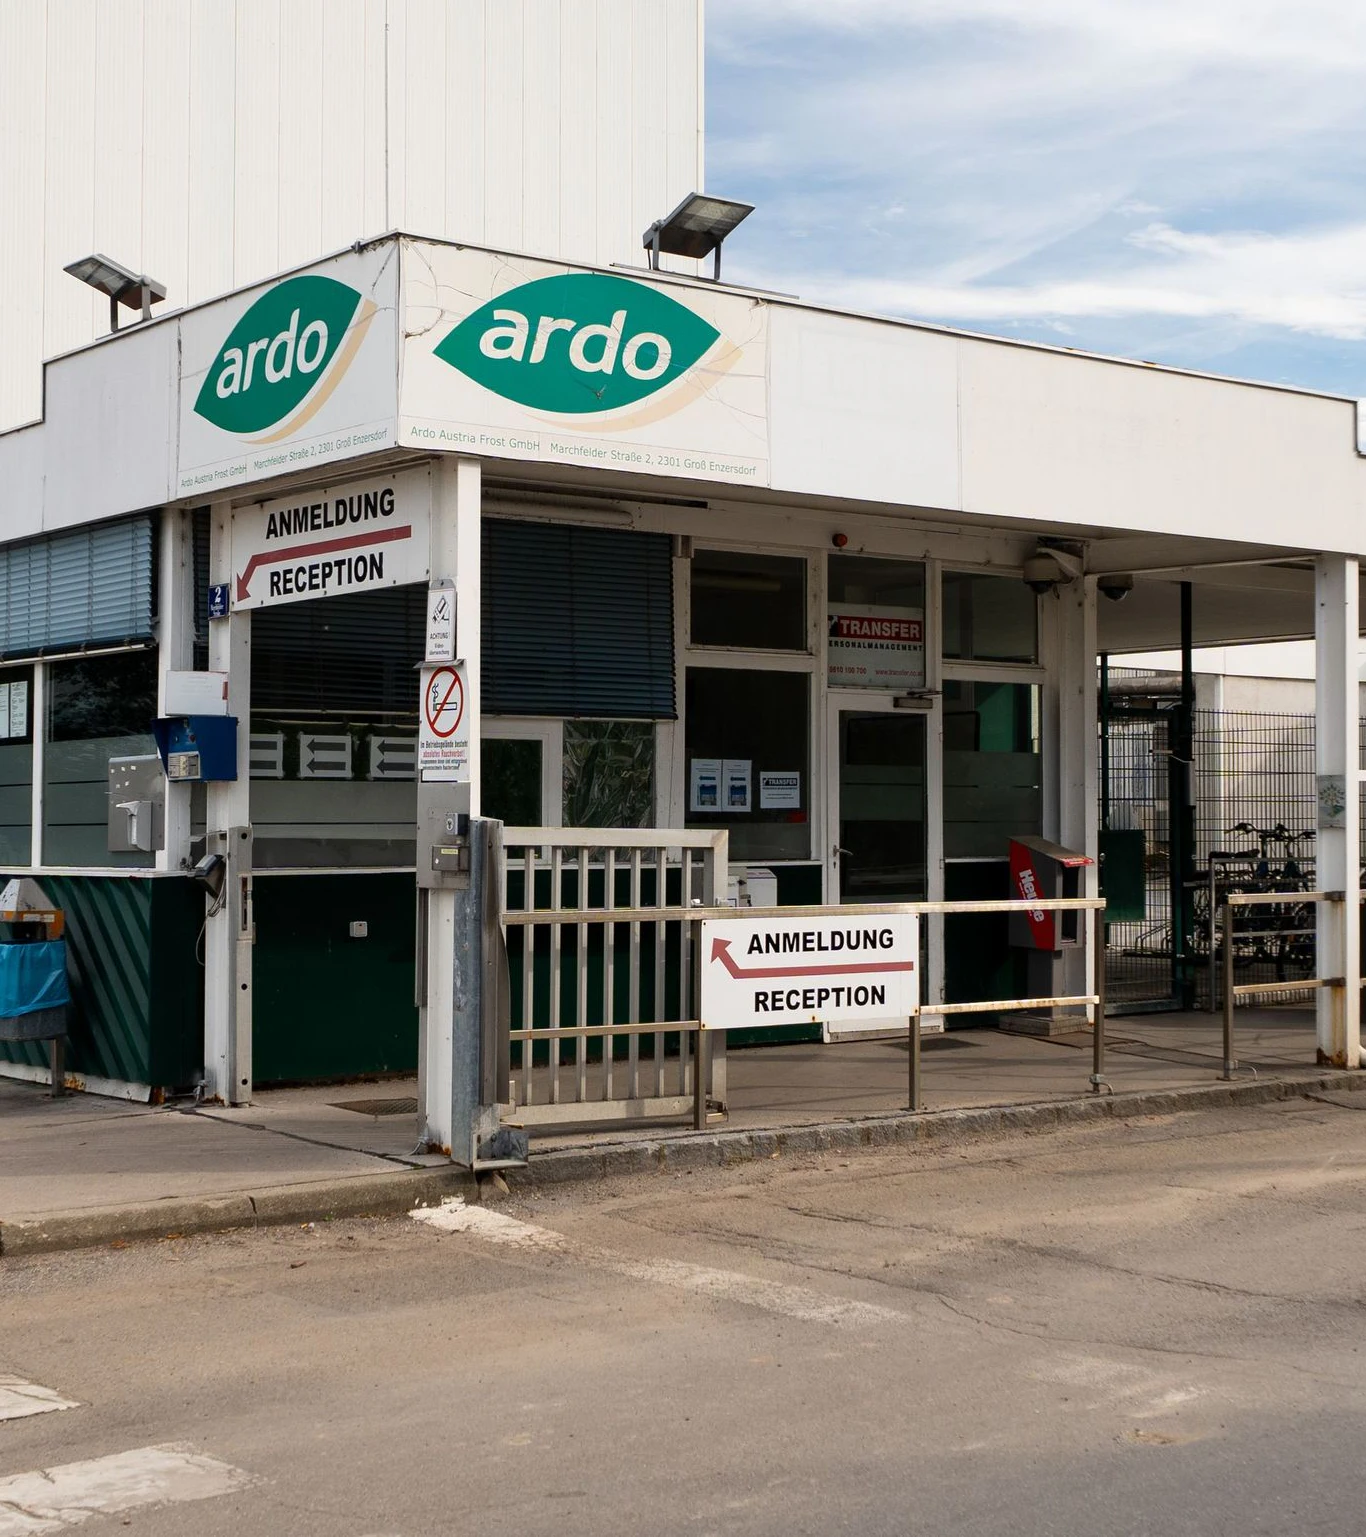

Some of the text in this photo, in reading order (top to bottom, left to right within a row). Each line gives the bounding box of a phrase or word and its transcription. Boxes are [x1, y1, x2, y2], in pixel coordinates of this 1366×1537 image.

[216, 308, 329, 399] ardo
[479, 309, 672, 380] ardo
[253, 428, 388, 471] Marchfelder Straße 2, 2301 Groß Enzersdorf
[411, 425, 541, 452] Ardo Austria Frost GmbH
[550, 441, 757, 477] Marchfelder Straße 2, 2301 Groß Enzersdorf
[181, 462, 247, 488] Ardo Austria Frost GmbH
[265, 487, 395, 540] ANMELDUNG
[269, 552, 384, 598] RECEPTION
[215, 586, 222, 603] 2
[840, 620, 920, 638] TRANSFER
[828, 640, 923, 652] ERSONALMANAGEMENT
[1019, 869, 1045, 922] Heue
[747, 928, 894, 955] ANMELDUNG
[754, 985, 885, 1012] RECEPTION
